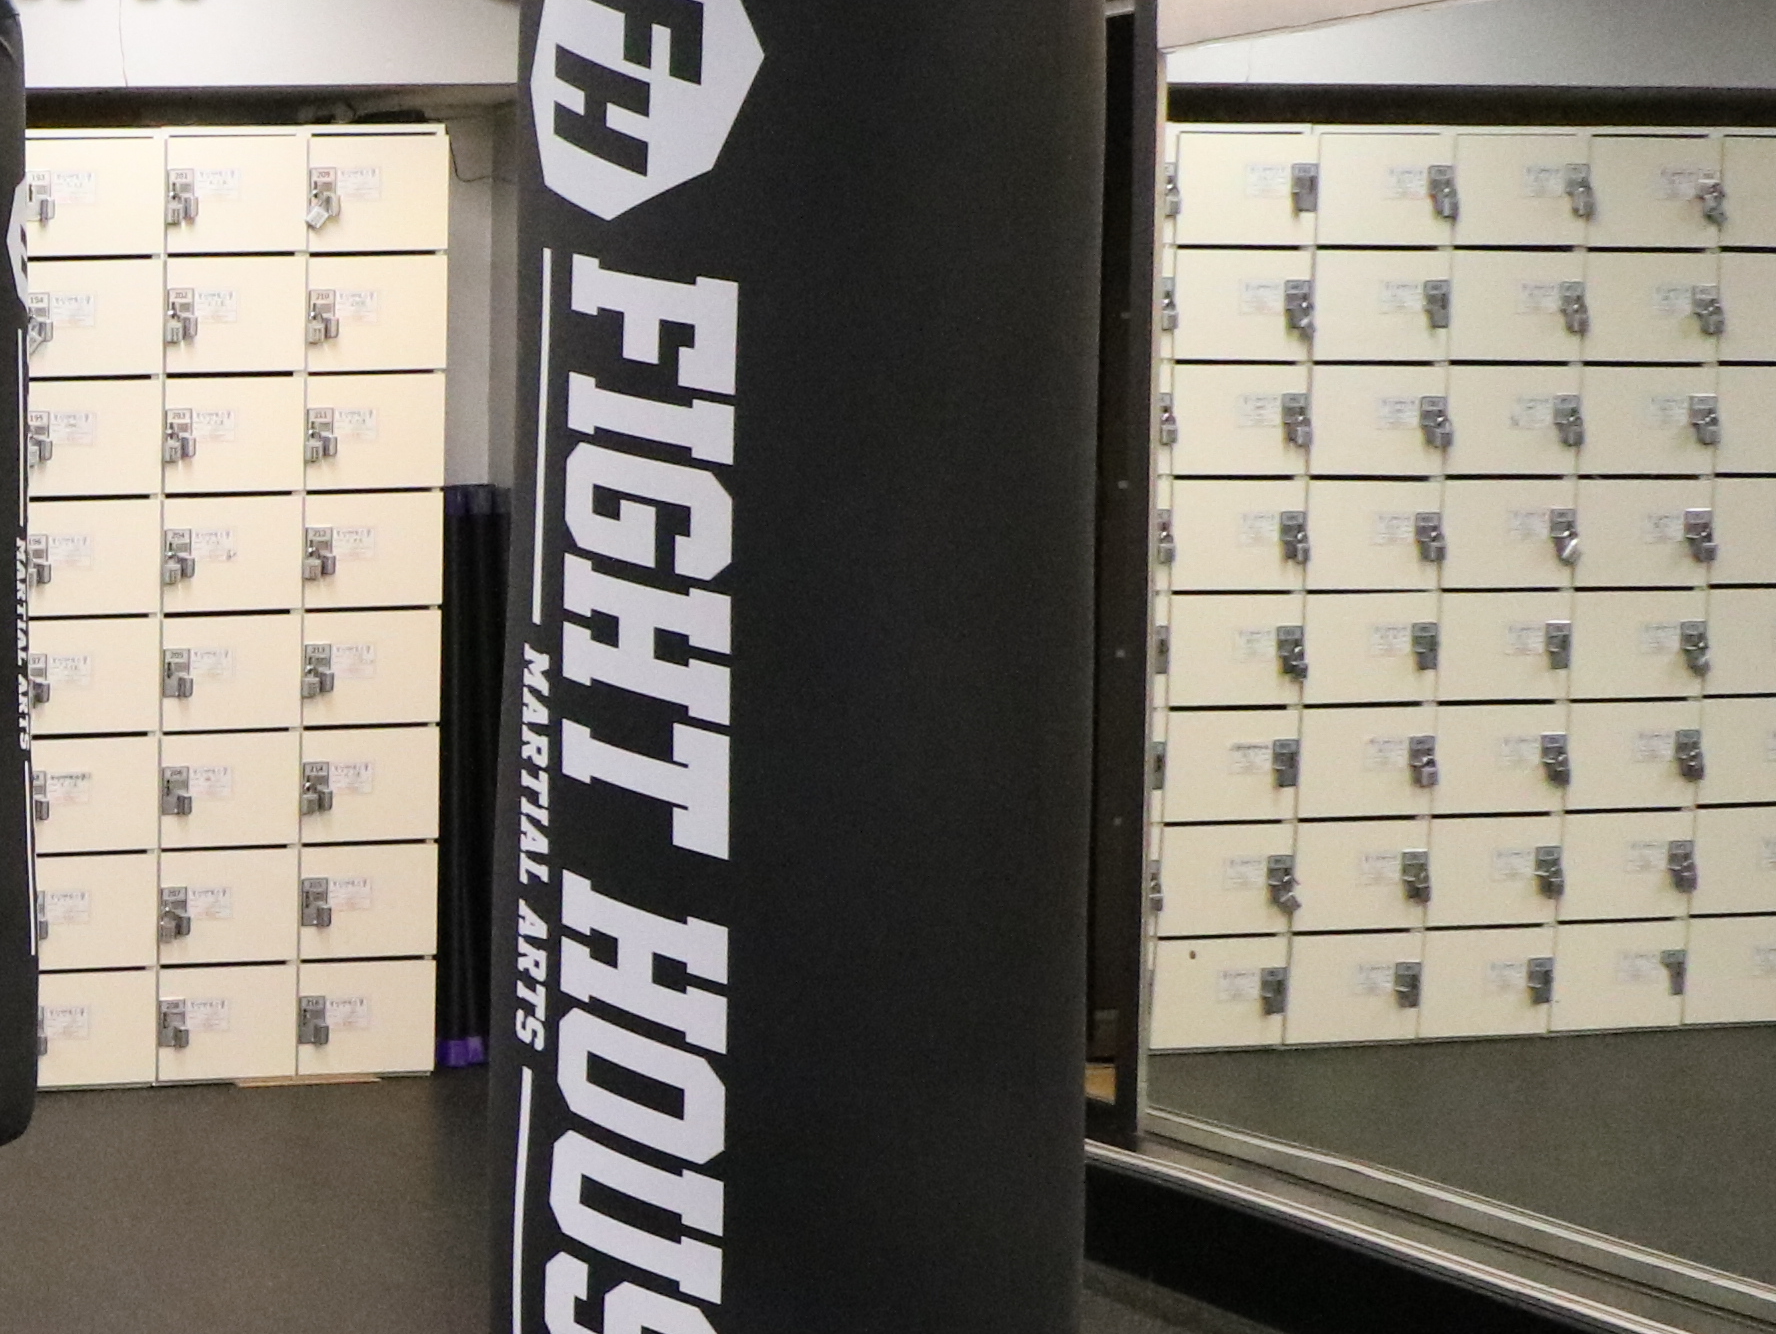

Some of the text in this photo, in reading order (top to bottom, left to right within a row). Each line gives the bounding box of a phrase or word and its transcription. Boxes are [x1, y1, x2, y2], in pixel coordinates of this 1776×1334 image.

[561, 253, 739, 861] FIGHT
[514, 642, 550, 1053] MARTIAL ARTS
